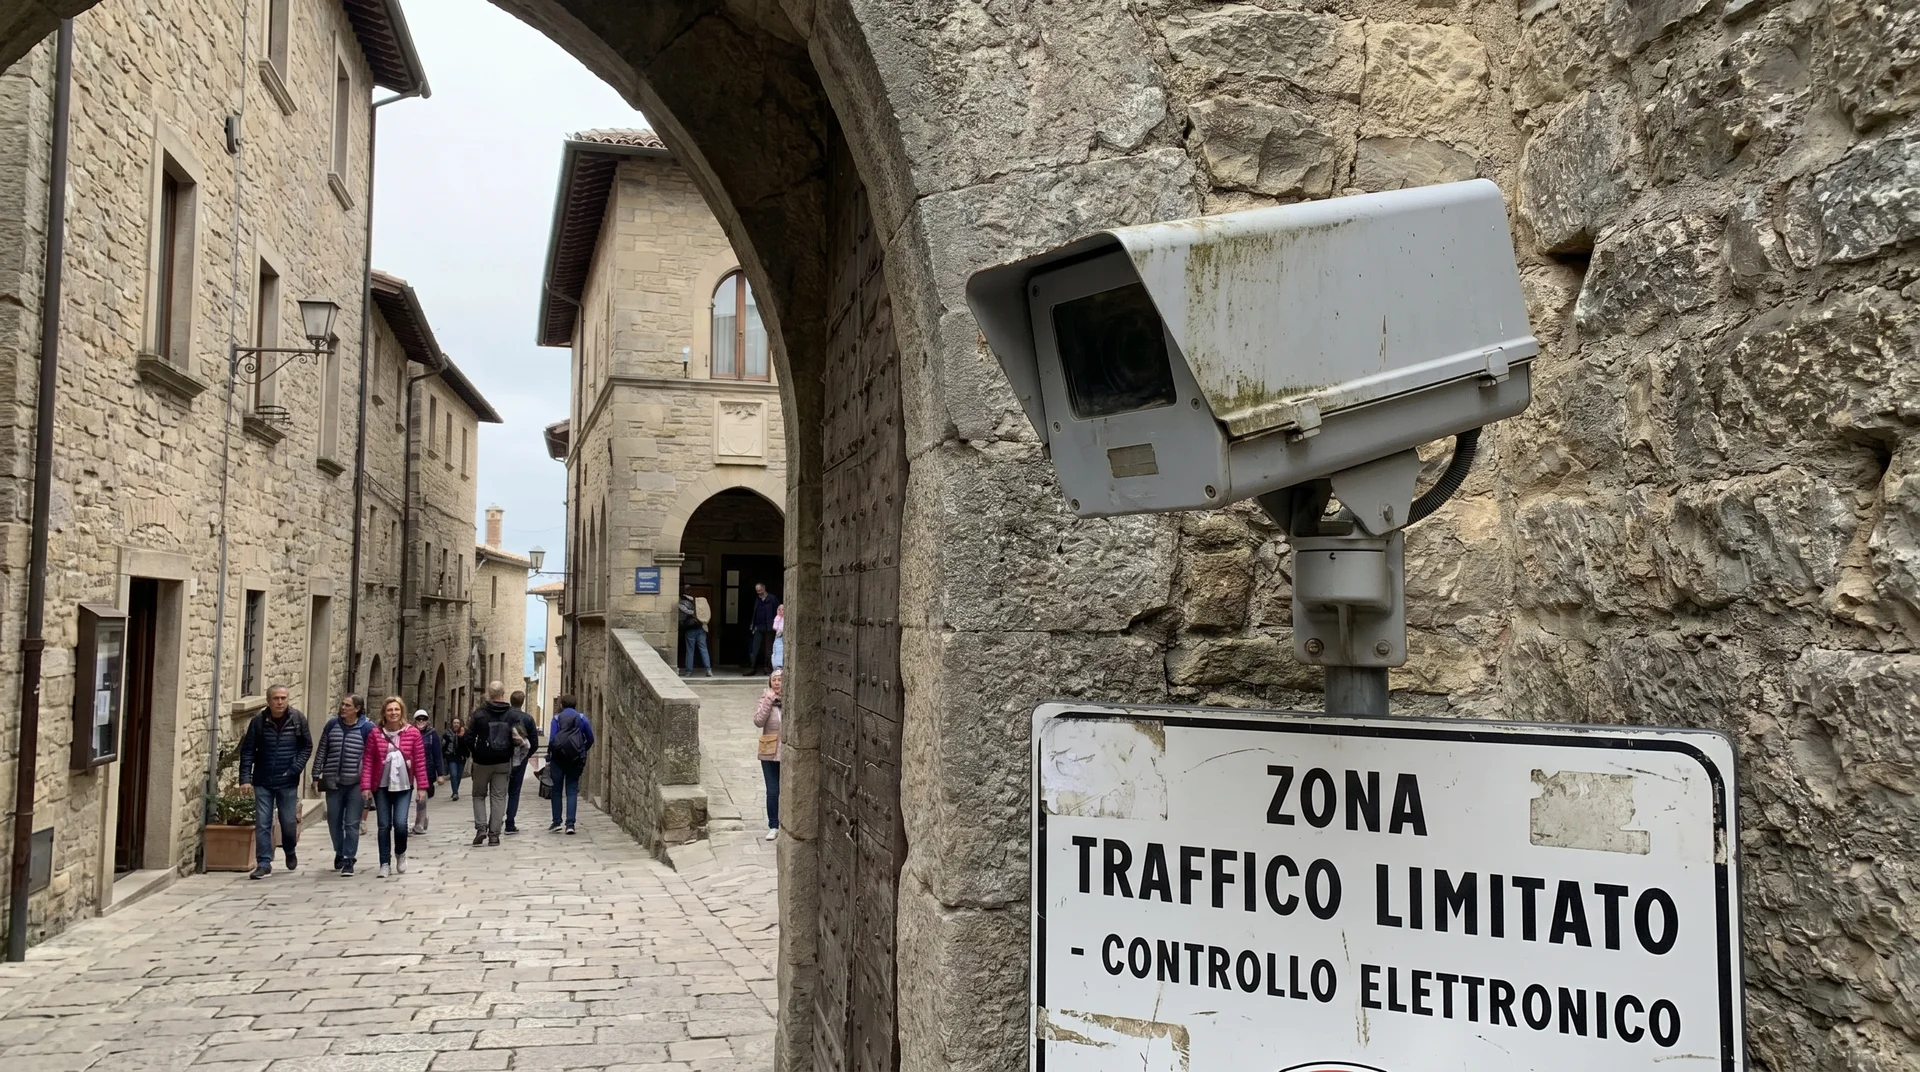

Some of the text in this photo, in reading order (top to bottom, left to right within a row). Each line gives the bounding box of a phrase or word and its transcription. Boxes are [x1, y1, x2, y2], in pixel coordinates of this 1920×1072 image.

[1266, 764, 1428, 837] ZONA
[1071, 835, 1679, 956] TRAFFICO LIMITATO
[1070, 933, 1681, 1048] - CONTROLLO ELETTRONICO
